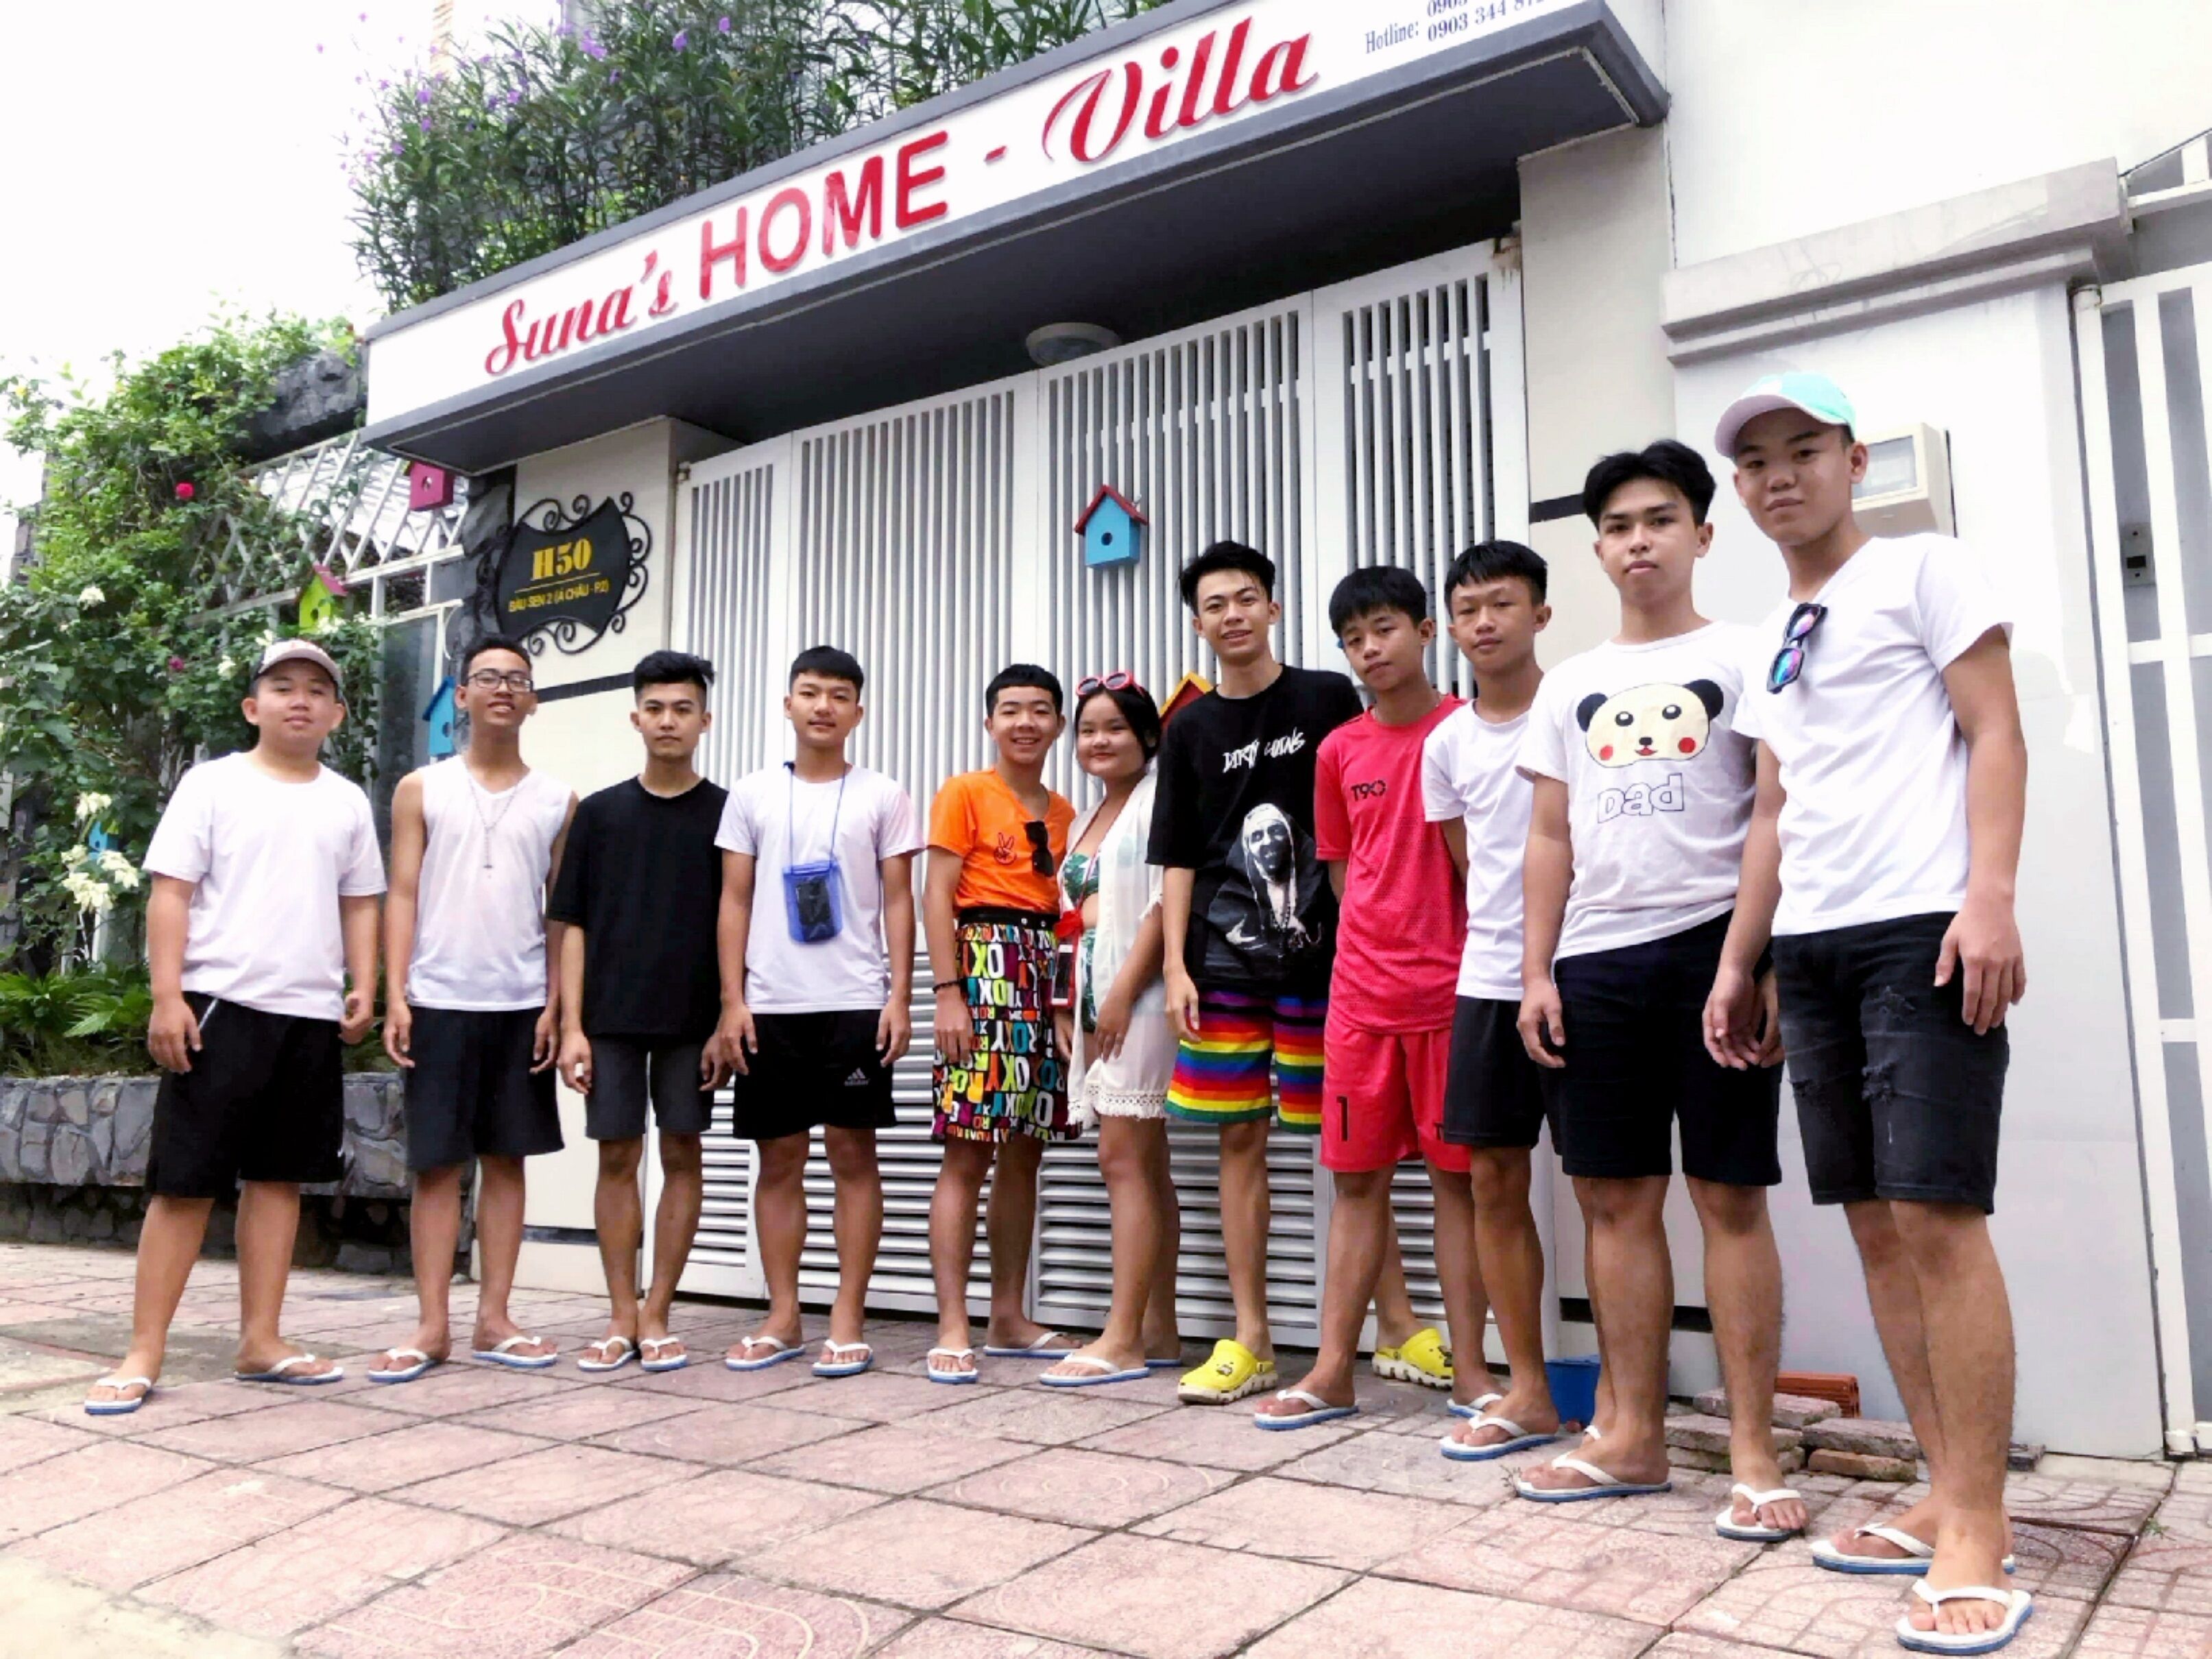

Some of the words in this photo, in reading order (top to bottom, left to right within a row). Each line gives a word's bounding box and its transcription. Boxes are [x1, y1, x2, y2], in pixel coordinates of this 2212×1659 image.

[1365, 21, 1419, 54] Hotline:
[1428, 12, 1469, 43] 0903
[1474, 0, 1506, 25] 344
[484, 249, 679, 376] Suna's
[699, 130, 948, 300] HOME
[1041, 15, 1320, 164] Villa
[530, 537, 592, 581] H50
